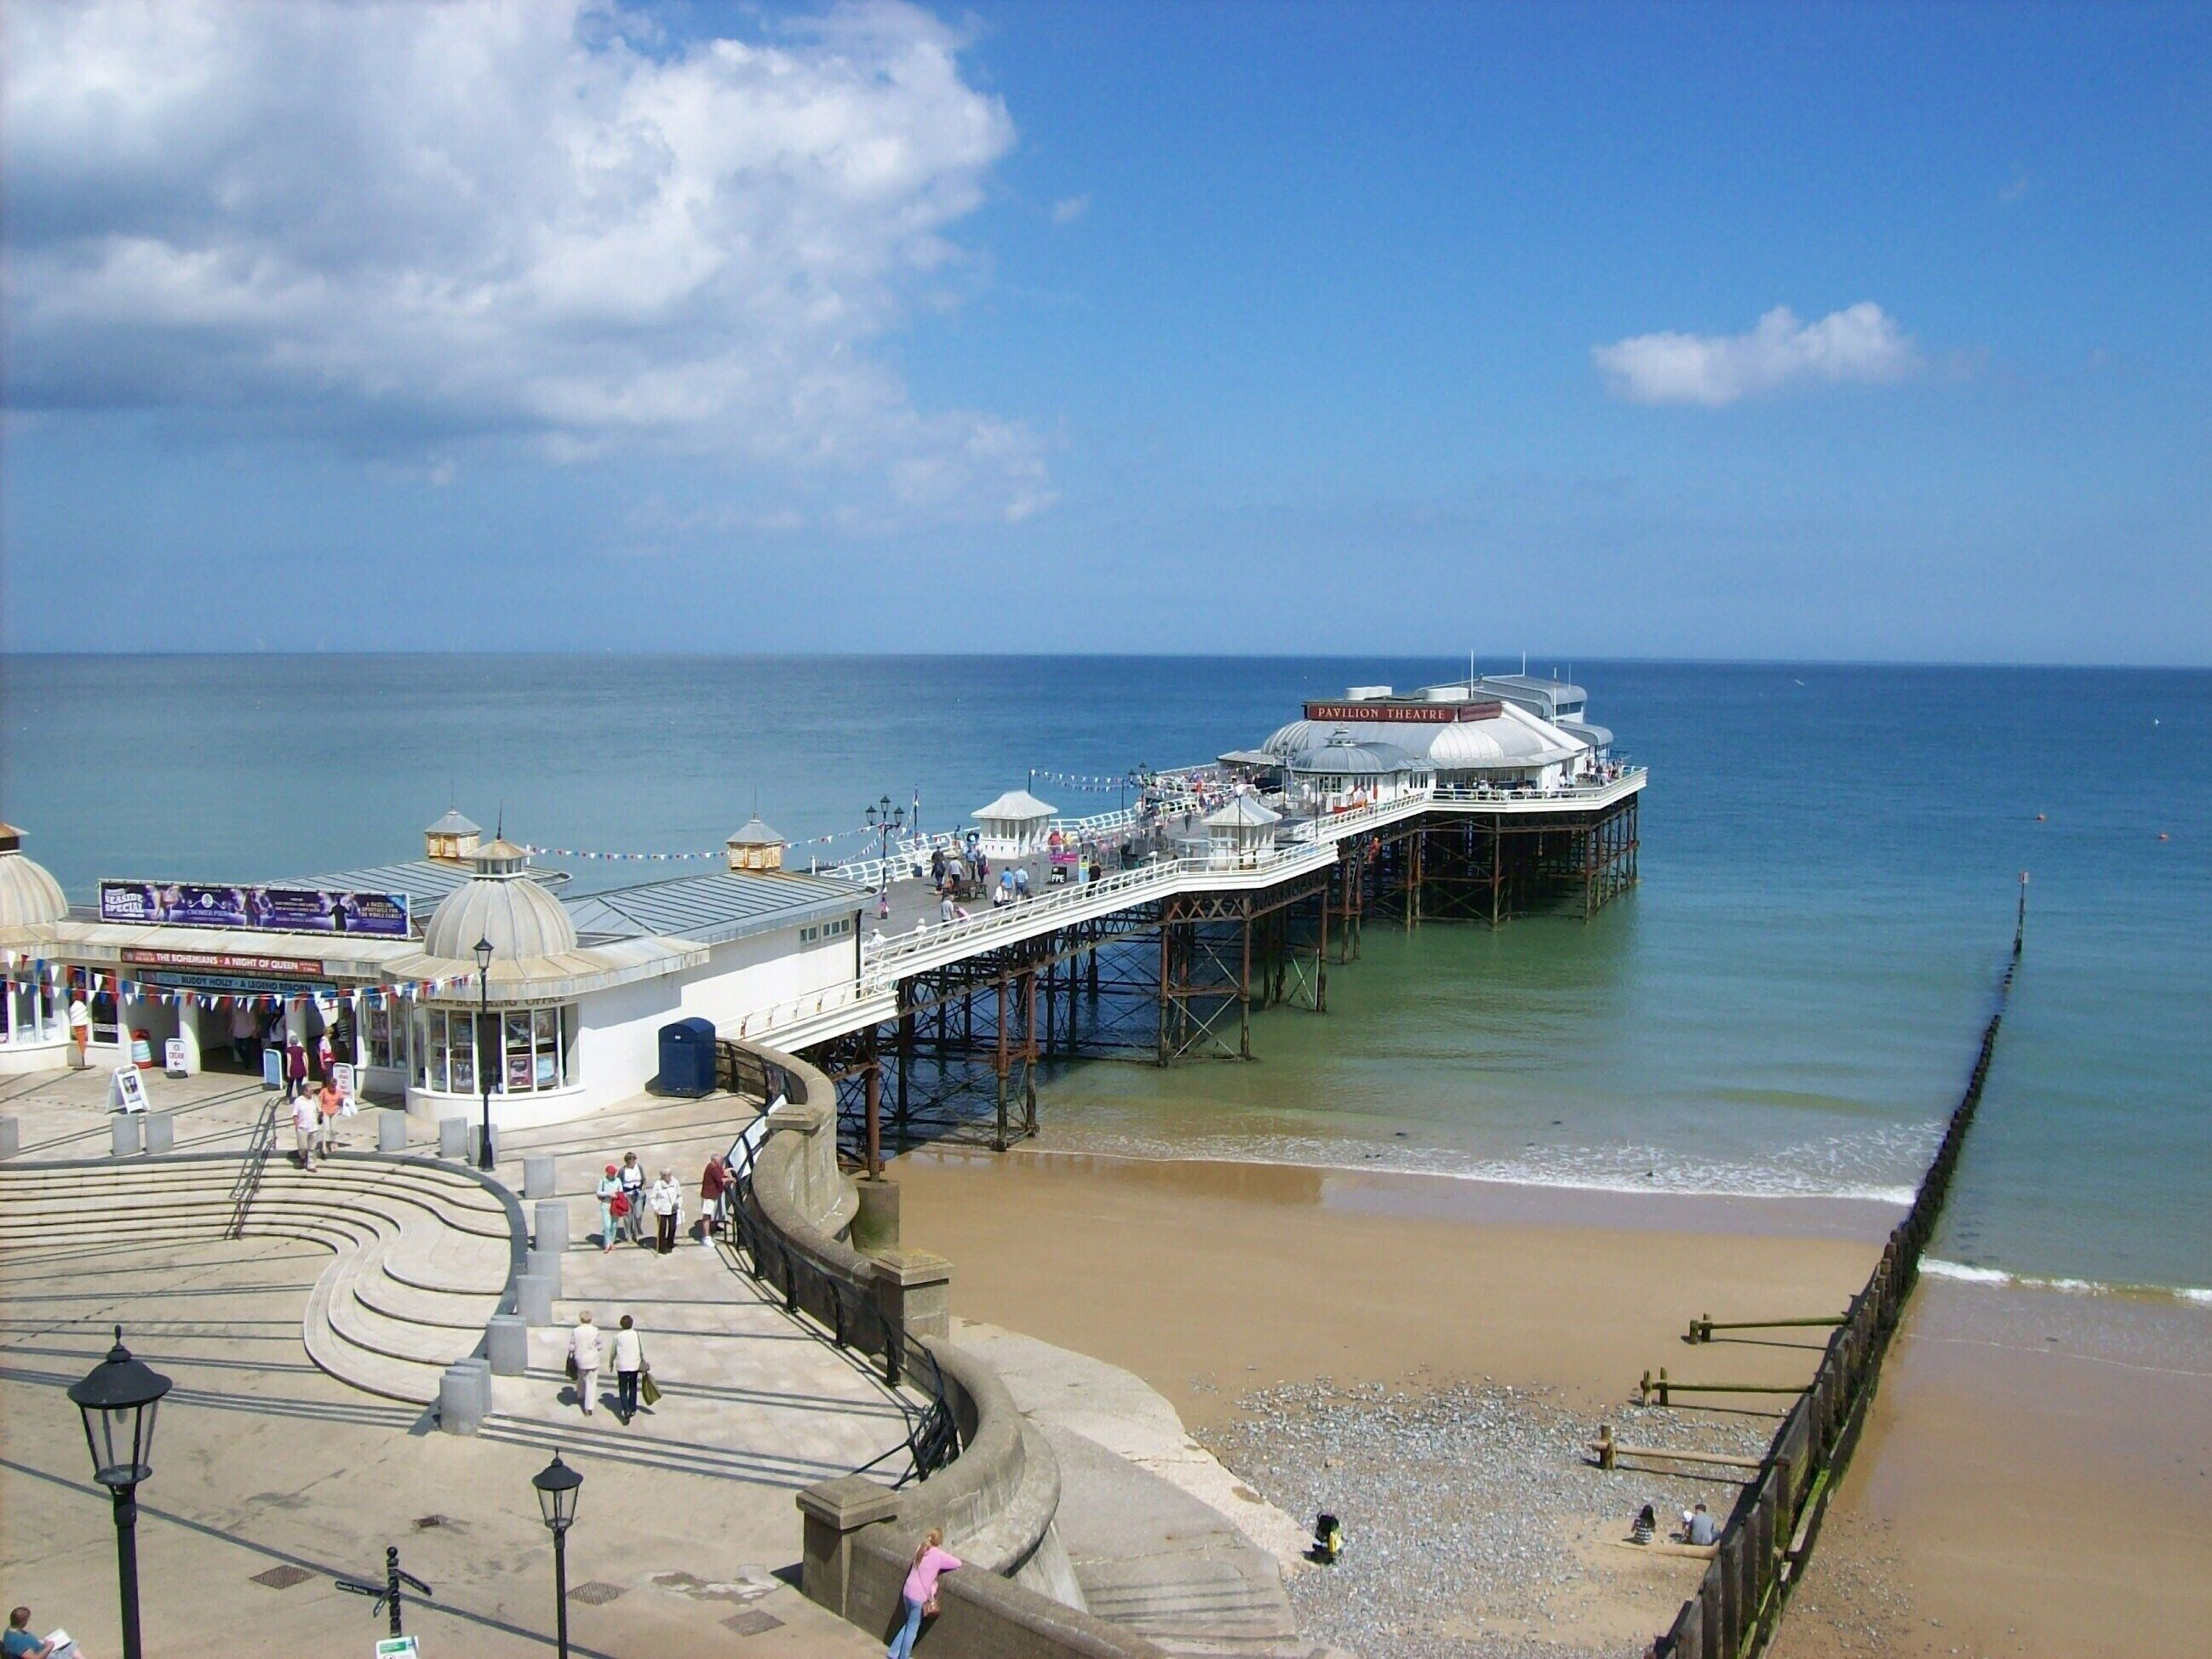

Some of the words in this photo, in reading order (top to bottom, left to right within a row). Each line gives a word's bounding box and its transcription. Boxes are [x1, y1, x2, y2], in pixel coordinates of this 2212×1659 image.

[1319, 707, 1378, 718] PAVILION
[1387, 708, 1445, 720] THEATRE
[105, 893, 143, 904] SEASIDE
[105, 902, 144, 913] SPECIAL
[156, 952, 170, 962] THE
[171, 953, 218, 964] BOHEMIANS
[224, 957, 231, 965] A
[232, 958, 257, 967] NIGHT
[258, 958, 270, 968] OF
[271, 960, 298, 970] QUEEN
[181, 975, 207, 985] BUDDY
[208, 977, 233, 987] HOLLY
[248, 981, 278, 990] LEGEND
[279, 983, 312, 993] REBORN
